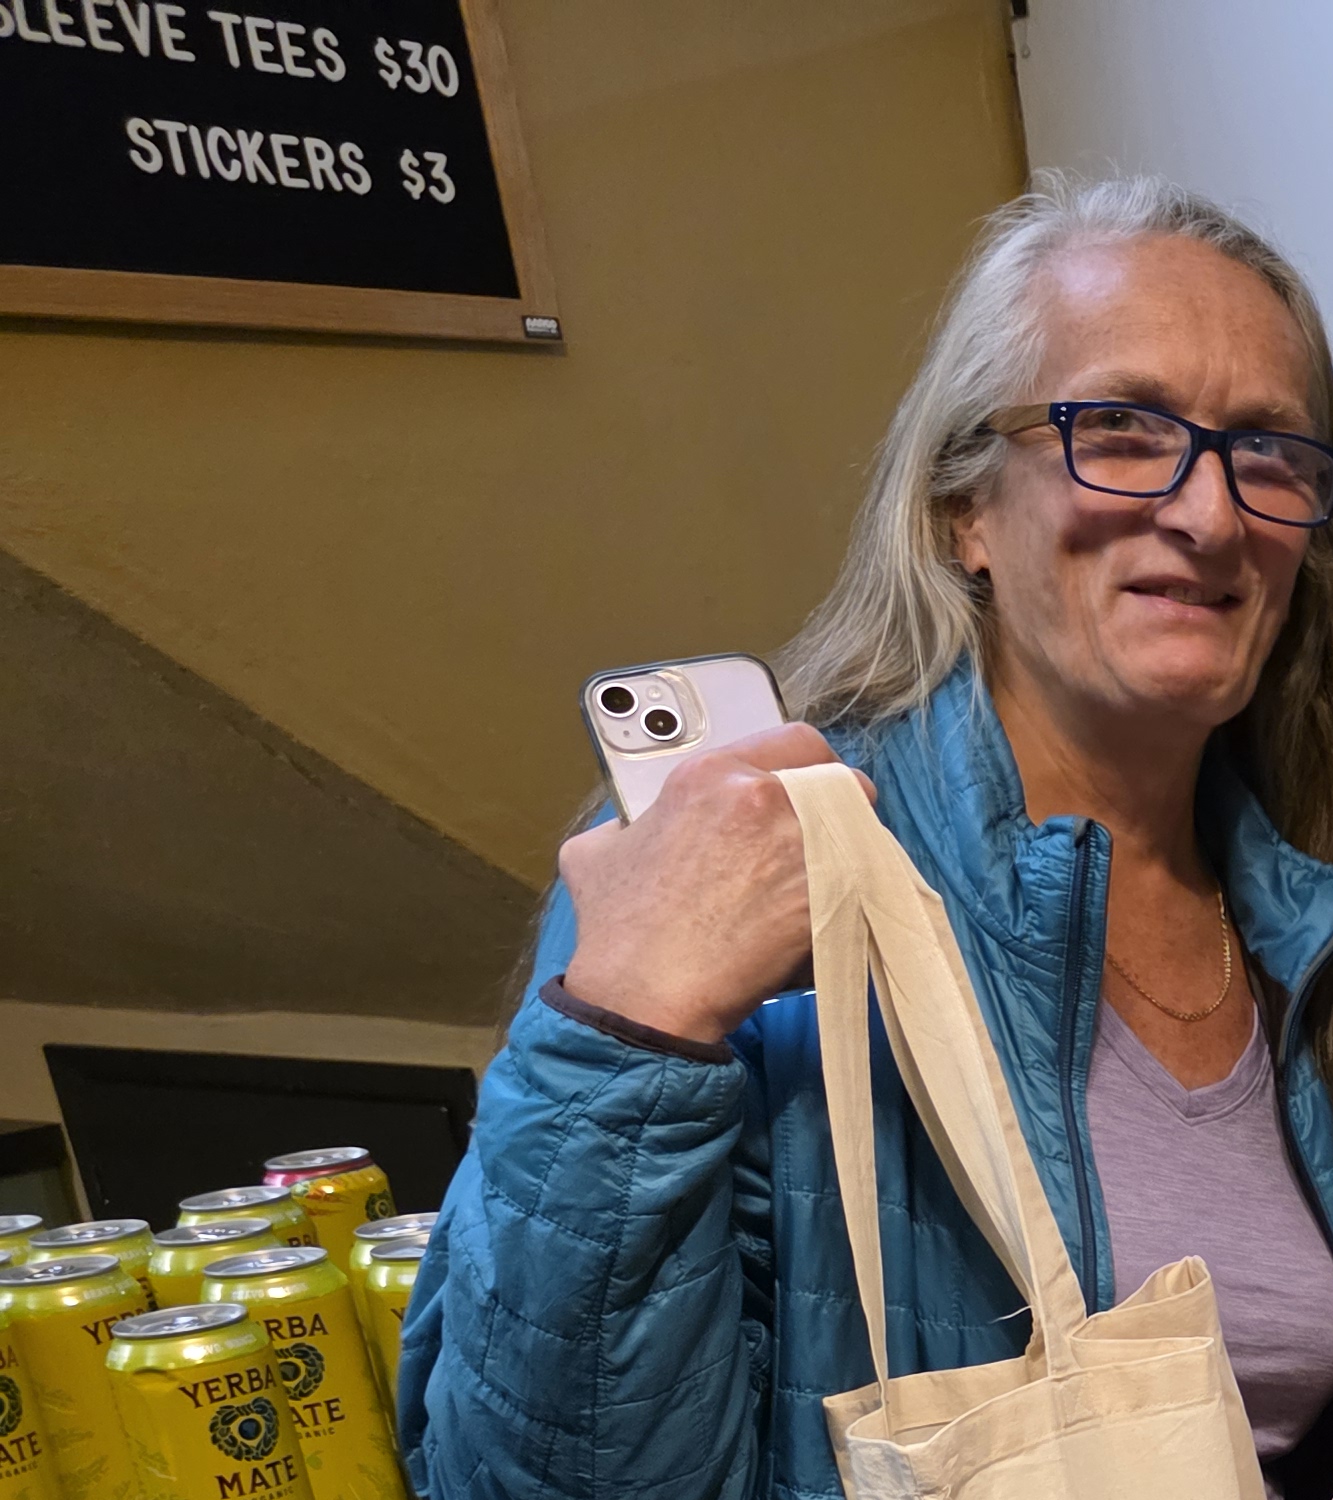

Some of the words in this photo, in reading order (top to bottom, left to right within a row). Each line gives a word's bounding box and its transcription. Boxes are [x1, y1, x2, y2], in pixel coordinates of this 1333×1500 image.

[0, 0, 195, 62] LEEVE
[207, 12, 346, 82] TEES
[374, 37, 459, 98] $30
[126, 118, 373, 196] STICKERS
[399, 149, 456, 204] $3
[256, 1313, 329, 1341] RBA
[178, 1364, 277, 1408] YERBA
[214, 1455, 298, 1500] MATE
